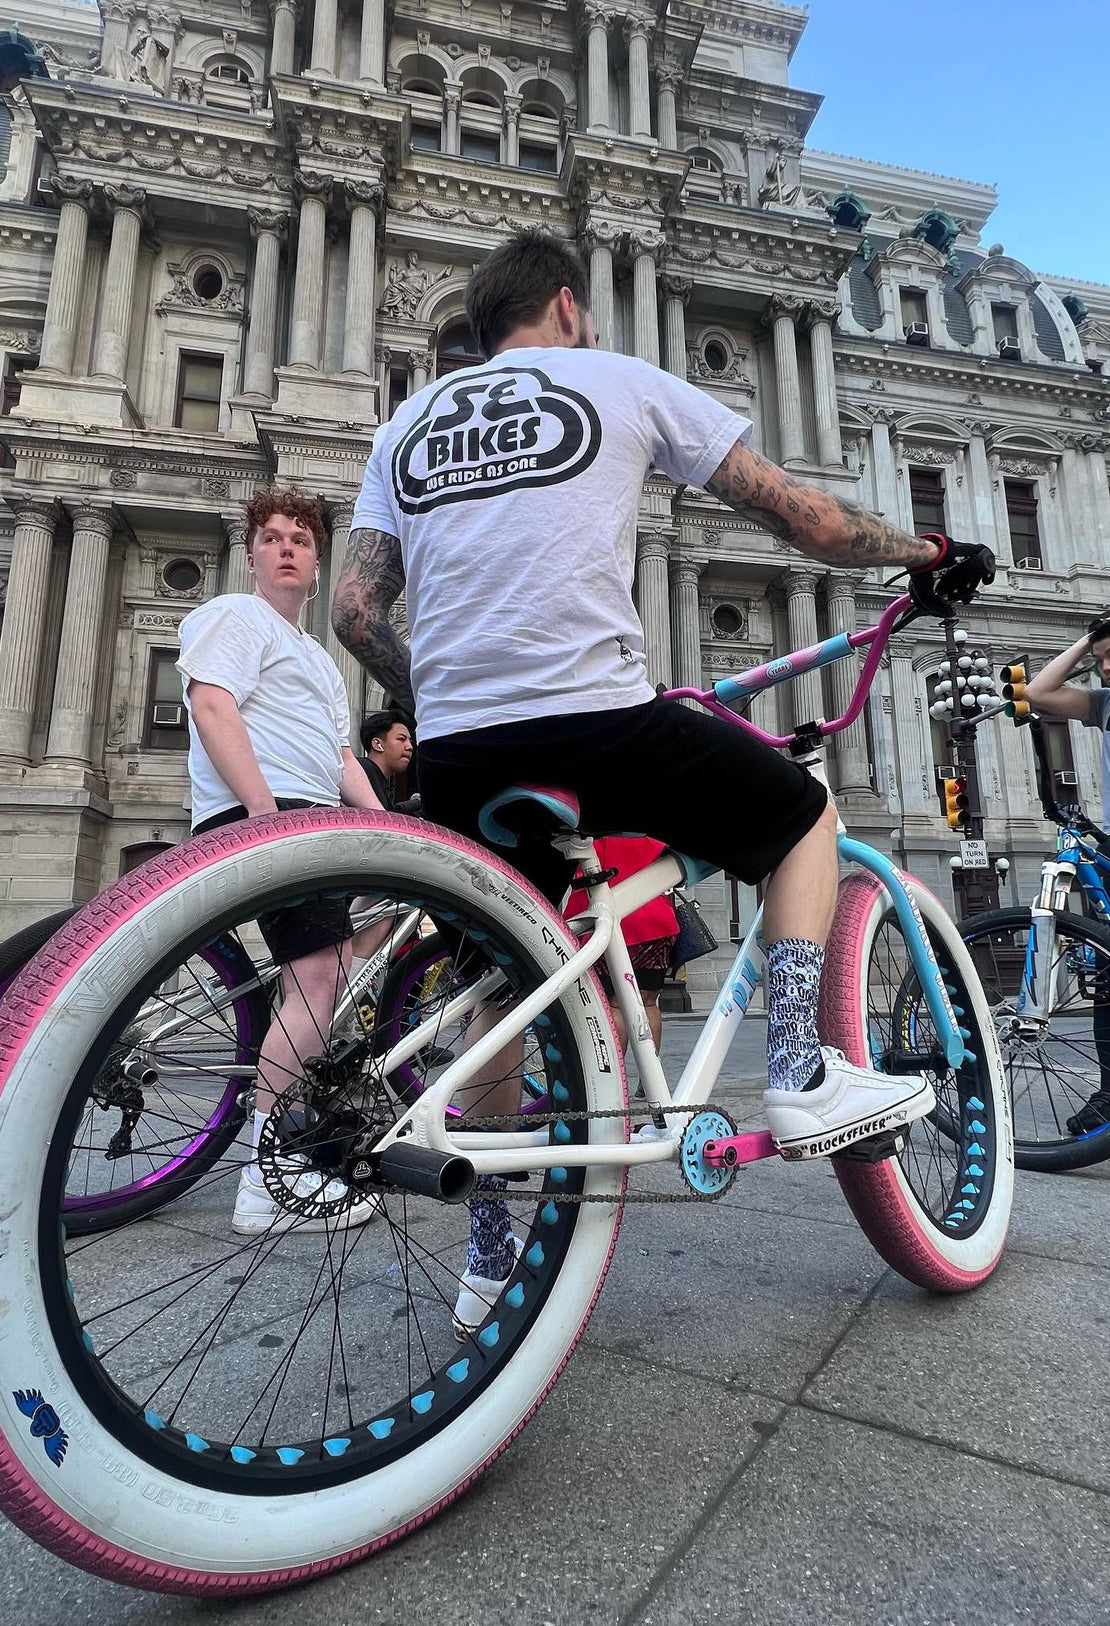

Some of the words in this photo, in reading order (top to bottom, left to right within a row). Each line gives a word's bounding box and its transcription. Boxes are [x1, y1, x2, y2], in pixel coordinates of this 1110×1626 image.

[430, 378, 535, 432] SE
[426, 416, 541, 471] BIKES
[426, 473, 444, 491] WE
[448, 468, 483, 485] RIDE
[486, 463, 504, 478] AS
[506, 457, 537, 473] ONE
[541, 926, 592, 1007] CHICNE
